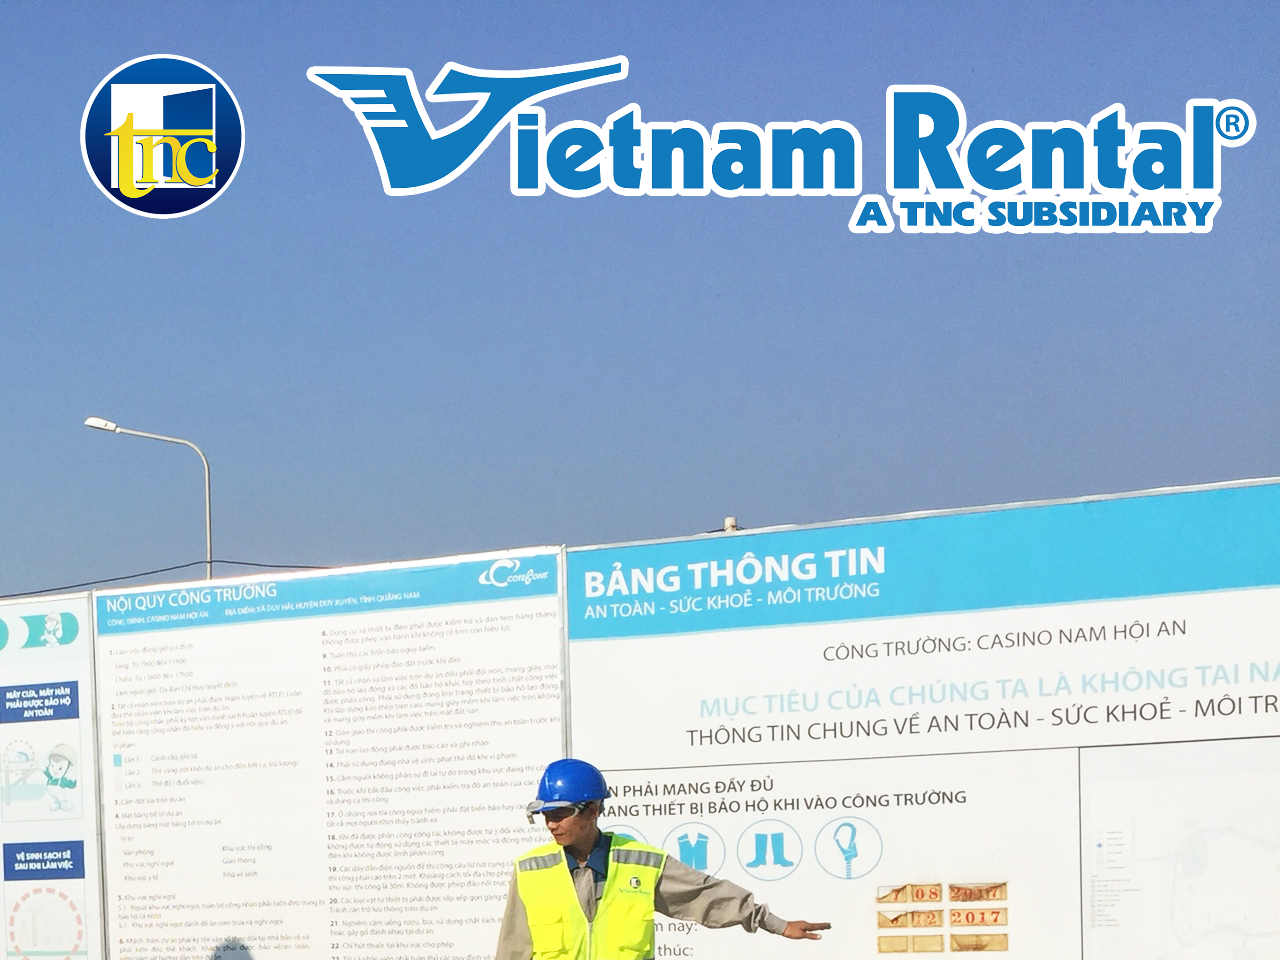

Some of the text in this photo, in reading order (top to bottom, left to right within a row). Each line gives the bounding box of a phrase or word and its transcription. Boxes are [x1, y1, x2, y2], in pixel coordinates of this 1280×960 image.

[584, 546, 885, 598] BẢNG THÔNG TIN
[106, 583, 277, 614] NỘI QUY CÔNG TRƯỜNG
[319, 599, 333, 607] DUY
[584, 604, 607, 620] AN
[610, 599, 655, 618] TOÀN
[669, 595, 703, 614] SỨC
[767, 586, 801, 606] MÔI
[804, 582, 880, 602] TRƯỜNG
[170, 612, 186, 621] NAM
[198, 610, 209, 619] AN
[823, 619, 1187, 662] CÔNG TRƯỜNG: CASINO NAM HỘI AN
[699, 663, 1240, 721] MỤC TIÊU CỦA CHÚNG TA LÀ KHÔNG TAI
[686, 725, 762, 746] THÔNG
[766, 723, 800, 741] TIN
[807, 718, 888, 740] CHUNG
[893, 711, 920, 735] VỀ
[927, 714, 959, 733] AN
[965, 708, 1029, 731] TOÀN
[1051, 703, 1098, 726] SỨC
[1194, 693, 1242, 718] MÔI
[623, 780, 658, 797] PHẢI
[663, 780, 711, 796] MANG
[750, 775, 773, 792] ĐỦ
[642, 799, 684, 816] THIẾT
[690, 801, 704, 818] BỊ
[708, 797, 741, 814] BẢO
[745, 797, 769, 815] HỘ
[773, 797, 800, 812] KHI
[804, 795, 838, 810] VÀO
[841, 792, 890, 809] CÔNG
[893, 790, 967, 806] TRƯỜNG
[14, 862, 28, 871] SAU
[668, 921, 698, 935] nay:
[951, 910, 1001, 924] 2017
[657, 944, 694, 957] thúc:
